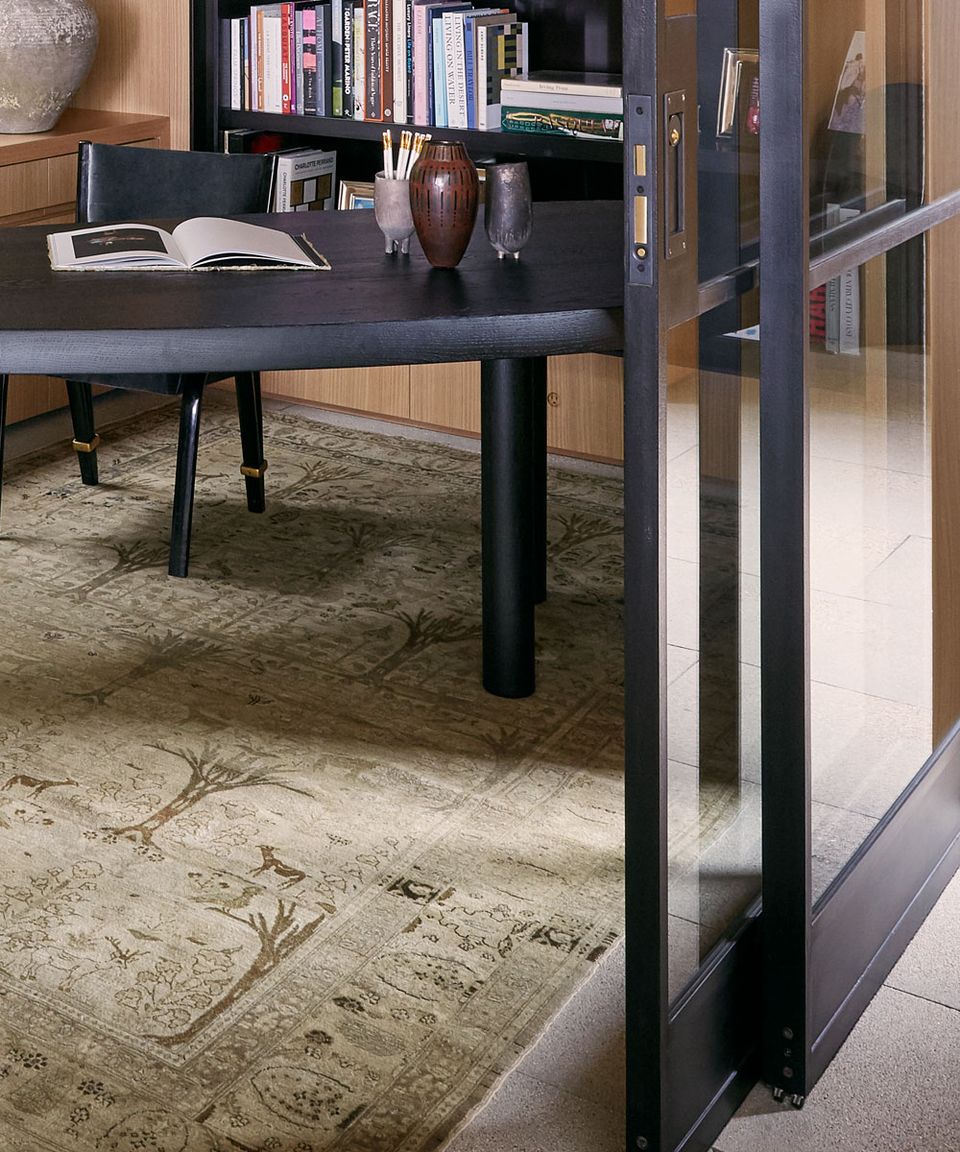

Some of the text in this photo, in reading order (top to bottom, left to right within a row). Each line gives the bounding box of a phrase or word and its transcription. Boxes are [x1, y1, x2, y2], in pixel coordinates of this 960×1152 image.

[456, 50, 462, 59] IN
[444, 16, 456, 105] LIVING ON WATER
[295, 160, 316, 170] CHARLOTTE
